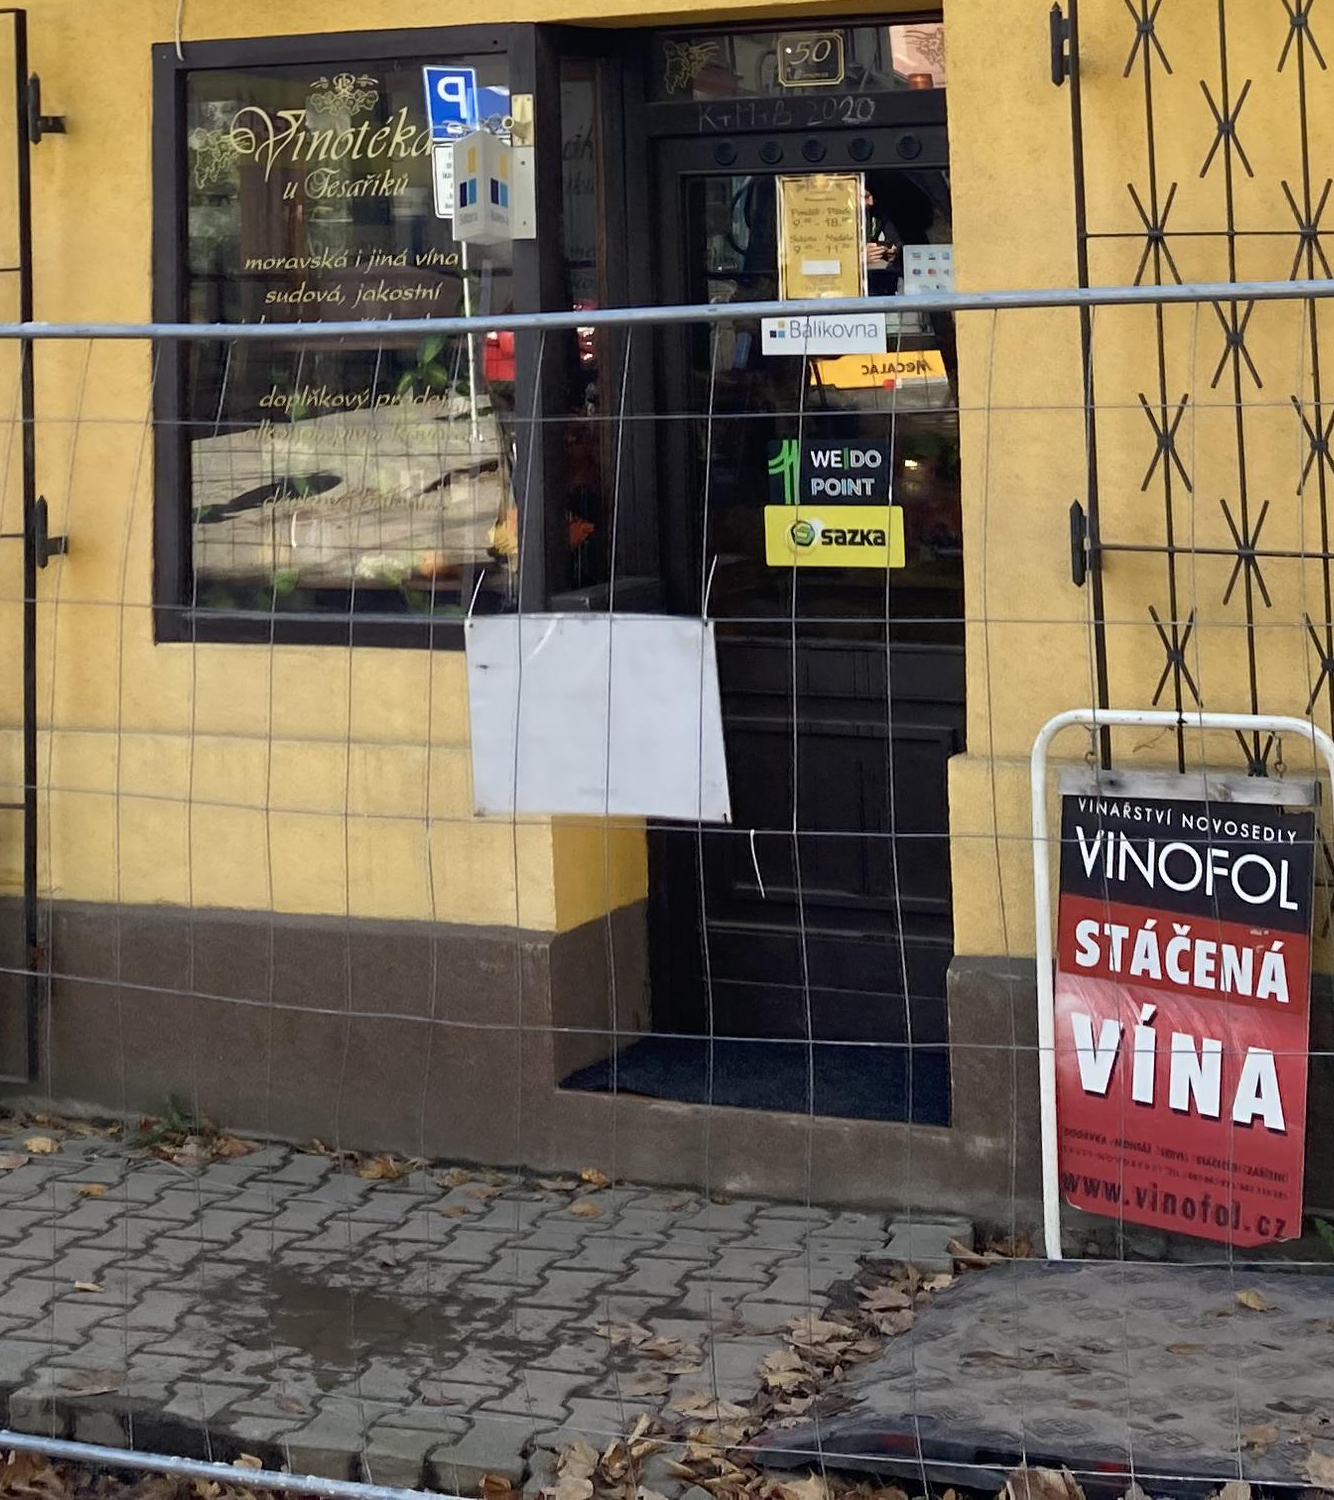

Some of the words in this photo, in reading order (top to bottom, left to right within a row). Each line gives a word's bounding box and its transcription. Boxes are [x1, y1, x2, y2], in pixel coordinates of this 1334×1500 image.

[790, 39, 832, 65] 50
[282, 180, 299, 200] u
[244, 247, 347, 270] moravská
[355, 249, 361, 268] i
[363, 248, 408, 275] jiná
[416, 248, 459, 267] vína
[265, 279, 347, 306] sudová,
[353, 279, 444, 308] jakostní
[259, 384, 371, 413] doplňkový
[375, 385, 450, 413] prdej
[810, 477, 875, 497] POINT
[1077, 796, 1173, 826] VINAŘSTVÍ
[1181, 814, 1297, 845] NOVOSEDLY
[1075, 825, 1299, 911] VINOFOL
[1075, 918, 1290, 1004] STÁČENÁ
[1070, 1003, 1287, 1133] VÍNA
[1062, 1171, 1287, 1239] www.vinofol.cz
